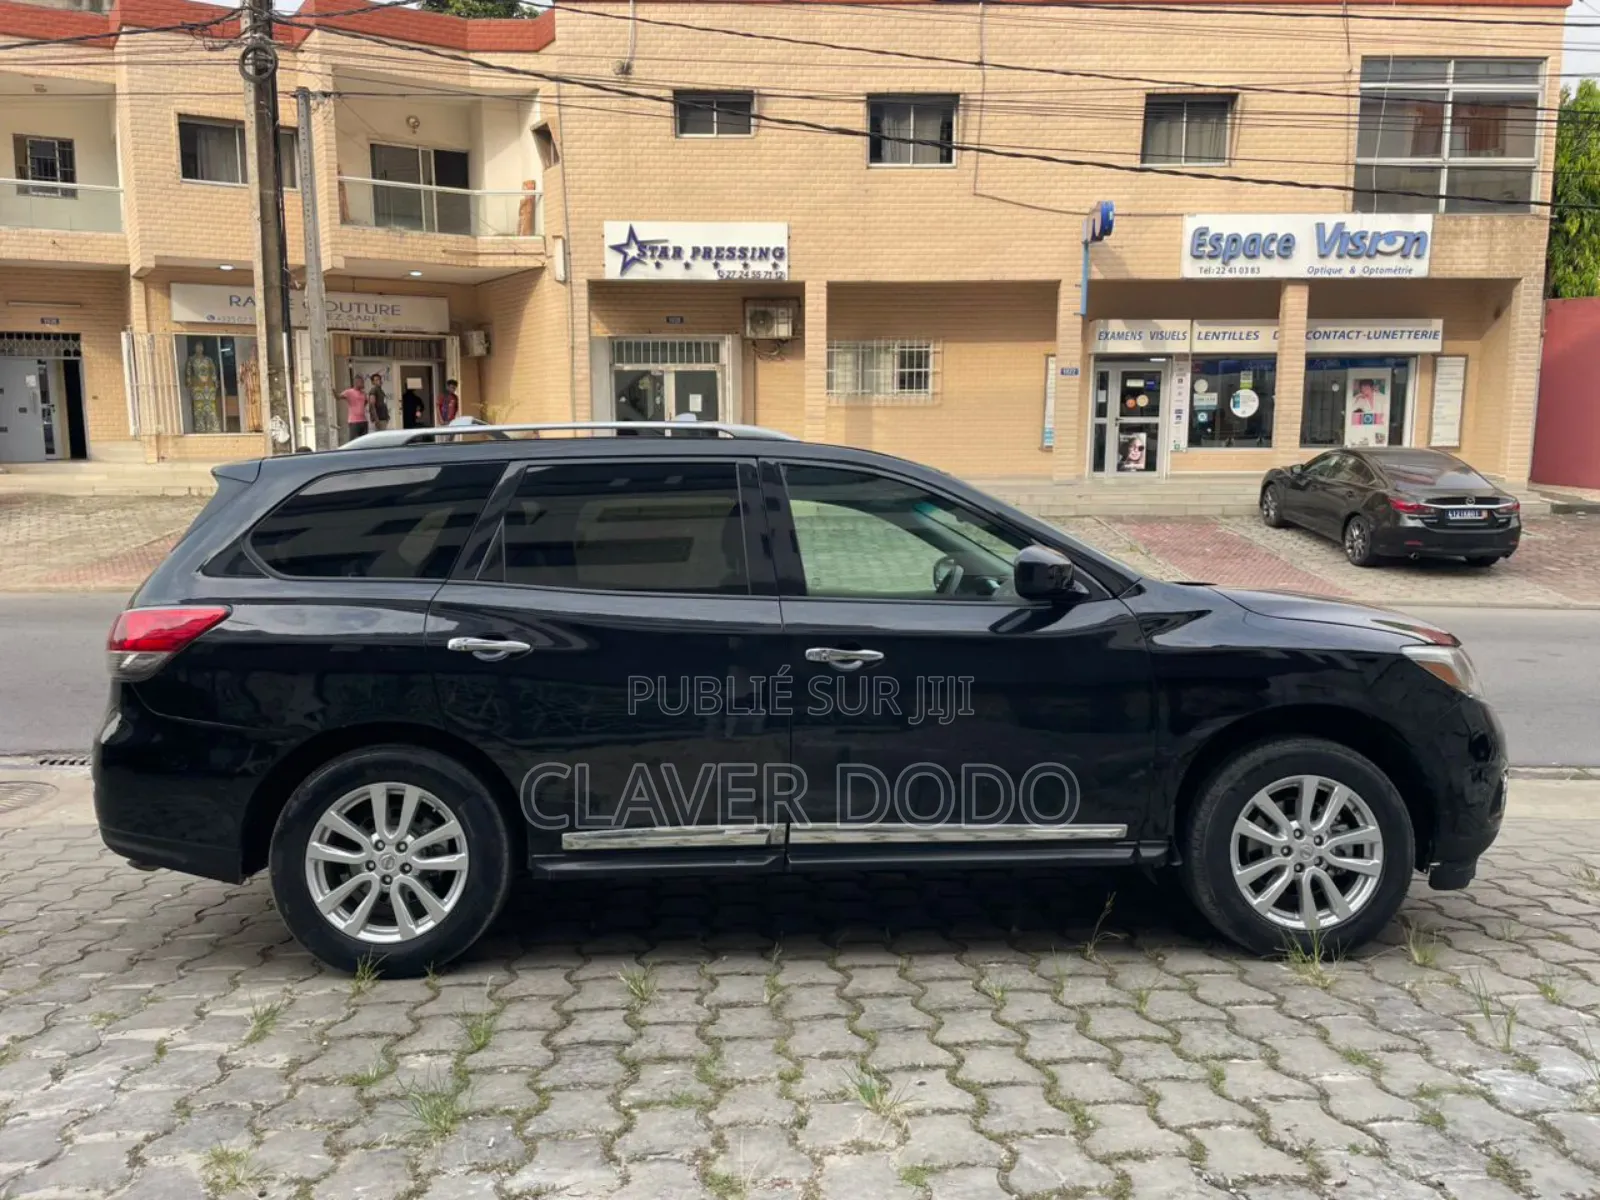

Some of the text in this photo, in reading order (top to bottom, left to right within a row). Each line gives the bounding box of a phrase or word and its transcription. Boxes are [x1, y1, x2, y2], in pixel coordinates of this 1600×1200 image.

[1190, 221, 1428, 266] Espace Vision
[637, 244, 786, 261] STAR PRESSING
[727, 270, 736, 279] 27
[738, 270, 750, 279] 24
[1307, 265, 1413, 275] Optique & Optométrie
[1098, 330, 1143, 341] EXAMENS
[1149, 330, 1188, 341] VISUELS
[1197, 330, 1260, 341] LENTILLES
[1305, 329, 1440, 341] CONTACT-LUNETTERIE
